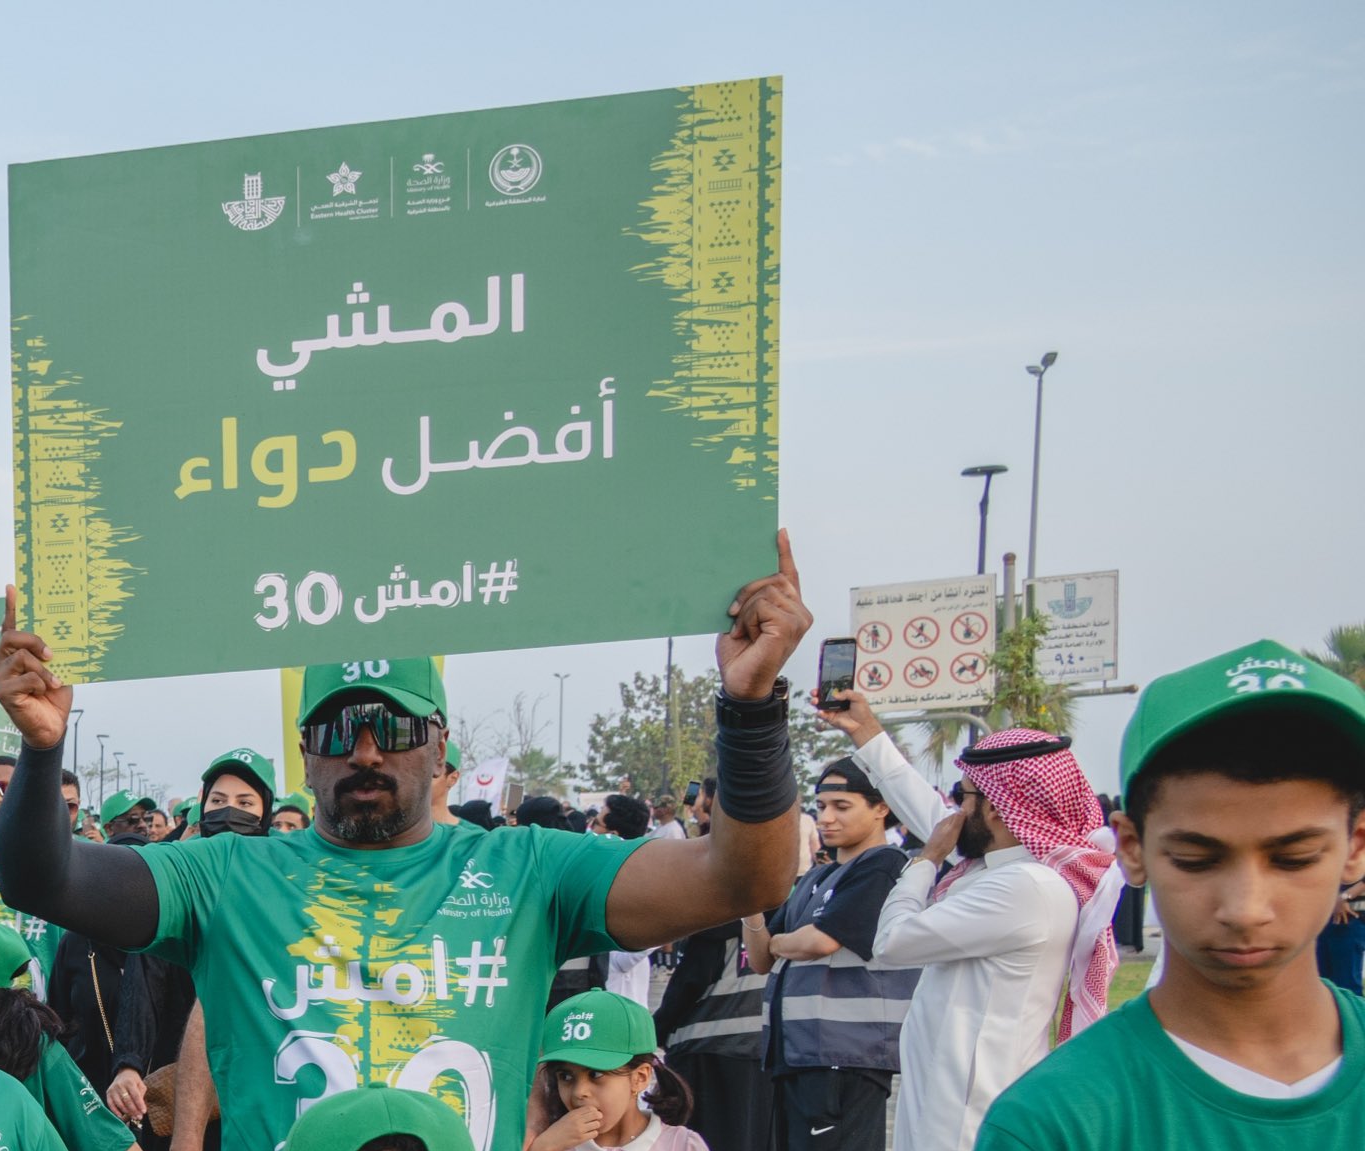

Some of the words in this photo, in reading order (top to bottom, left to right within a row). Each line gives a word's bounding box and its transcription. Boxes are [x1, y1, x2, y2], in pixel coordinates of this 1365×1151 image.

[310, 212, 334, 220] Eastern
[335, 209, 356, 217] Health
[356, 206, 379, 215] Cluster
[255, 273, 526, 392] المشي
[381, 376, 615, 496] أفضل
[173, 417, 357, 508] دواء
[252, 571, 343, 632] 30
[353, 558, 520, 624] #امش
[1225, 656, 1307, 677] #امش
[437, 907, 468, 919] Ministry
[470, 908, 481, 917] of
[483, 907, 513, 917] Health
[442, 894, 477, 906] الصح
[480, 893, 511, 908] وزارة
[262, 933, 509, 1022] #امش
[561, 1022, 592, 1042] 30
